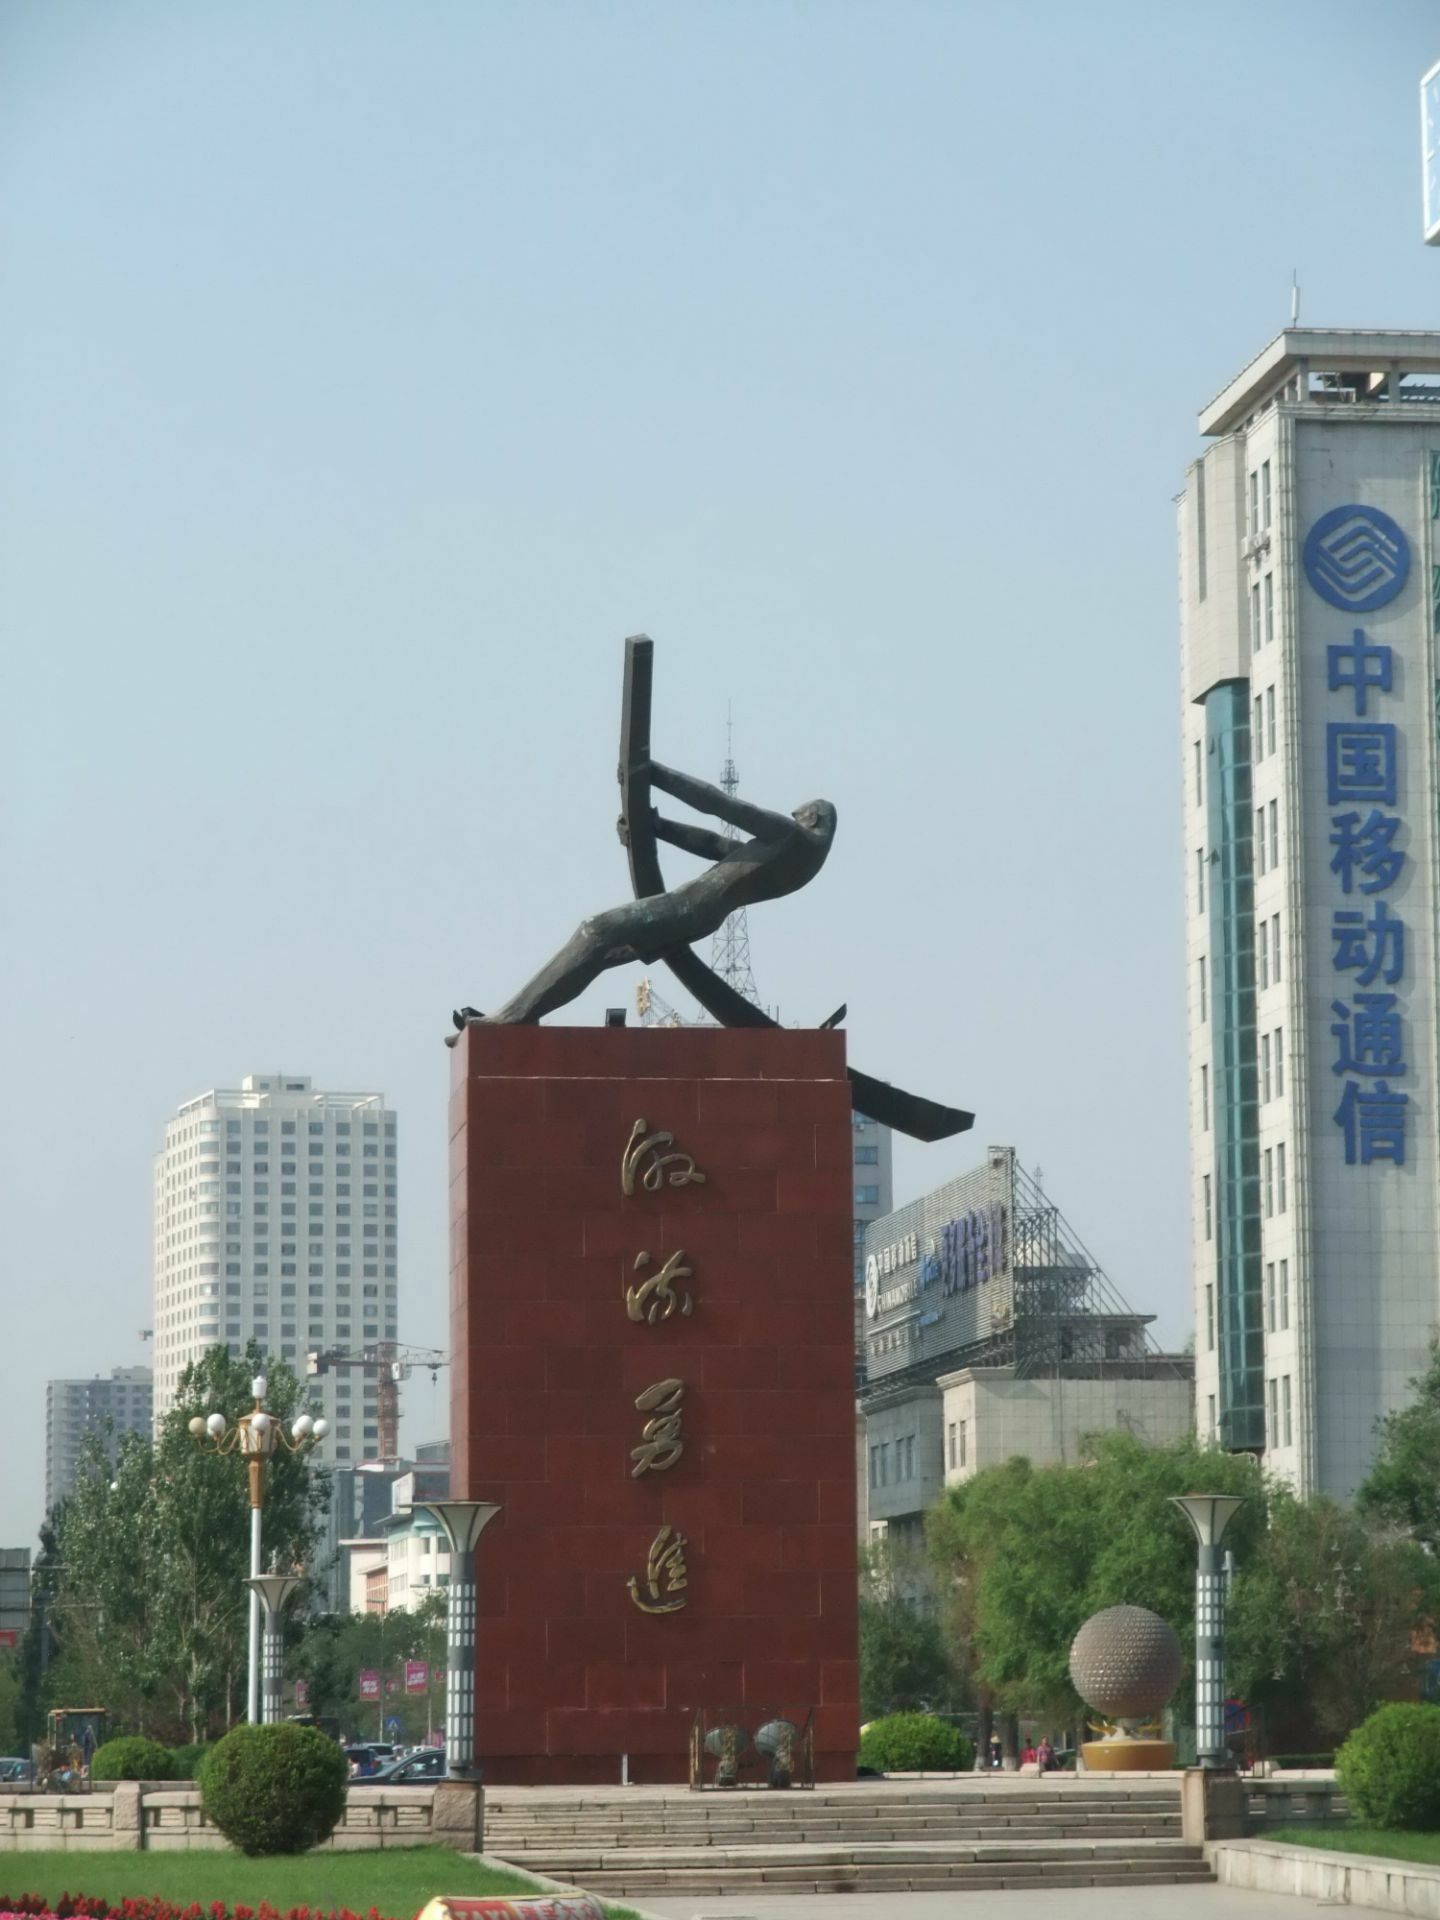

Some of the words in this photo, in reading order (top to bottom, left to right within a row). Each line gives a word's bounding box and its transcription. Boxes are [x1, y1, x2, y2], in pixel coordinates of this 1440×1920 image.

[1326, 628, 1410, 1166] 中国移动通信
